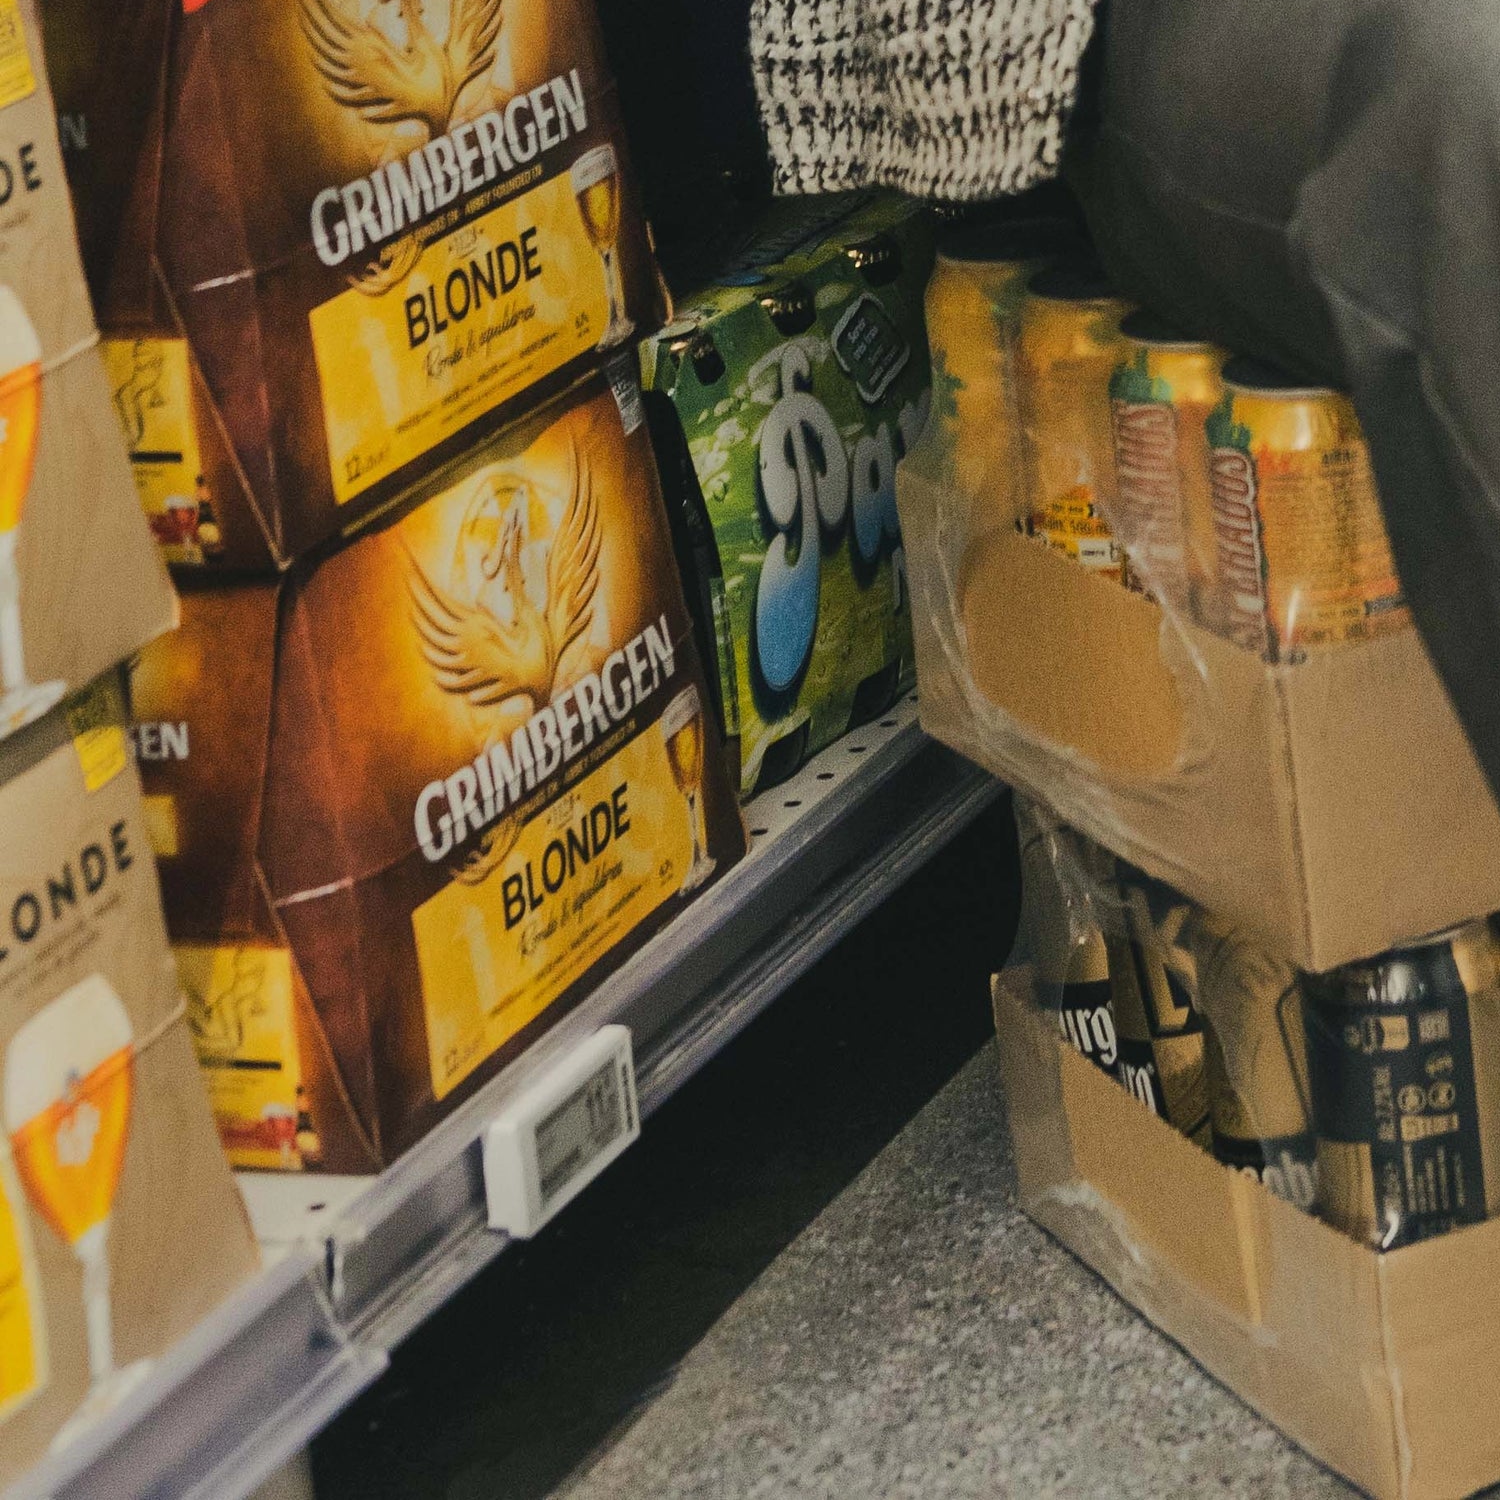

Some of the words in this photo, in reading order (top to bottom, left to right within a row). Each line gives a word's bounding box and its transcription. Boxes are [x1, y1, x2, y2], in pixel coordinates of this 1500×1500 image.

[310, 67, 589, 268] GRIMBERGEN
[404, 226, 543, 350] BLONDE
[413, 614, 678, 864] GRIMBERGEN
[500, 780, 633, 932] BLONDE
